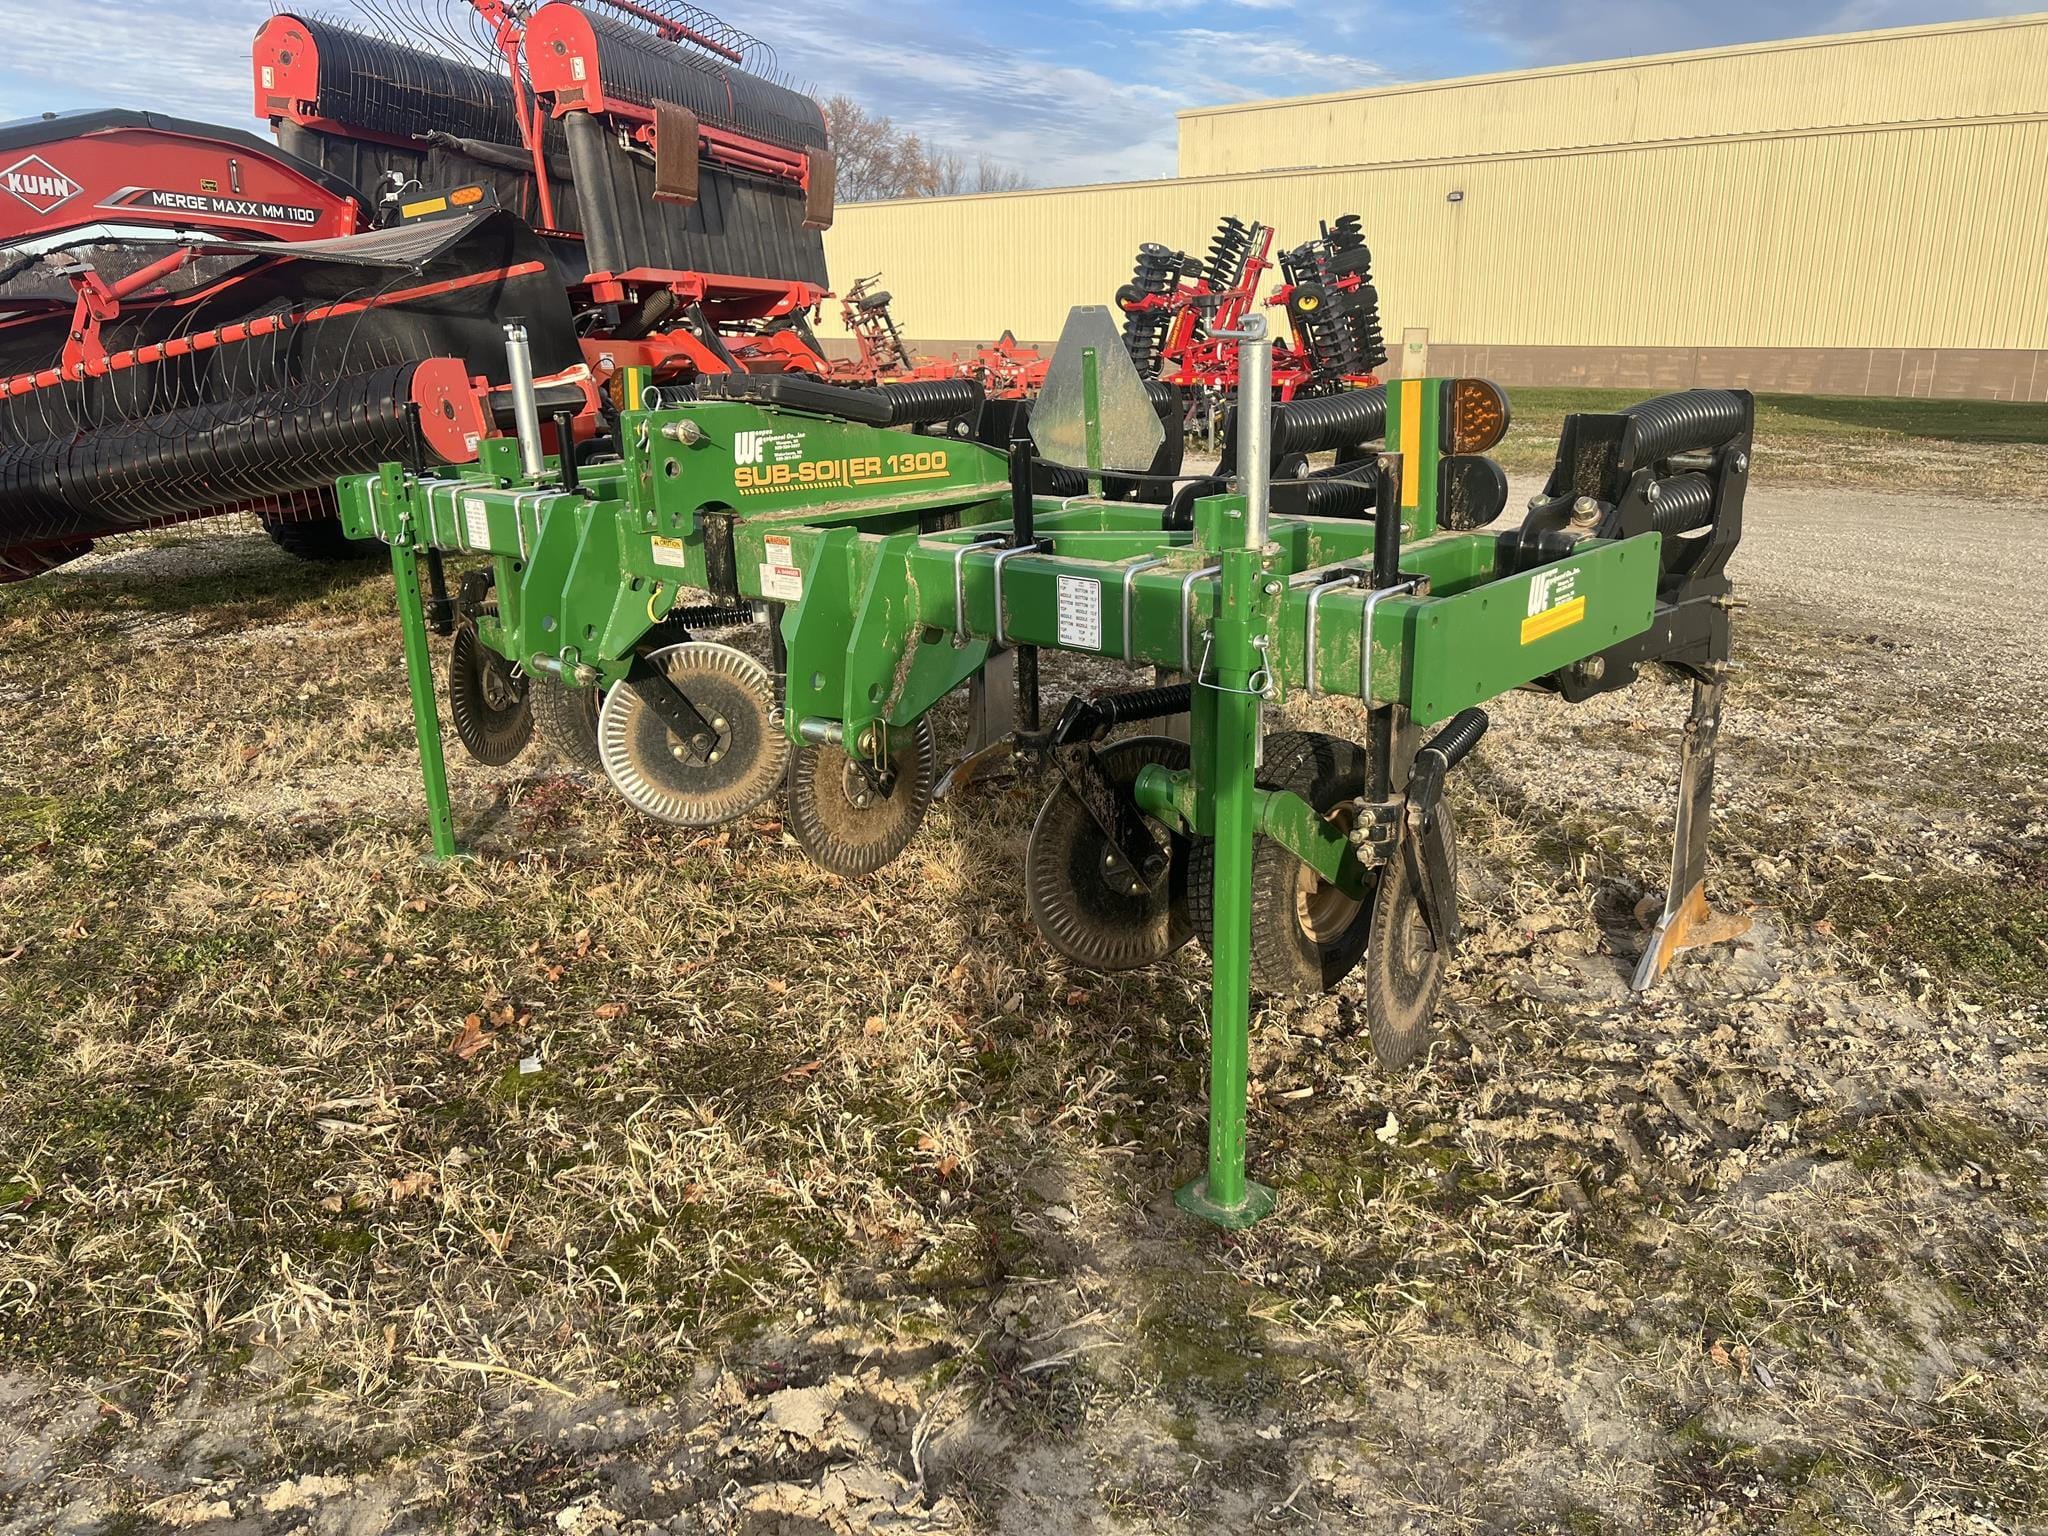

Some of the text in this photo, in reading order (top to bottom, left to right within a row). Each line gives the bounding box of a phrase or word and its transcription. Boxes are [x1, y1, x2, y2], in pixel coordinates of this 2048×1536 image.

[8, 173, 69, 197] KUHN
[152, 192, 314, 222] MERGE MAXX MM 1100
[734, 450, 947, 488] SUB-SOILER 1300
[659, 540, 681, 548] CAUTION
